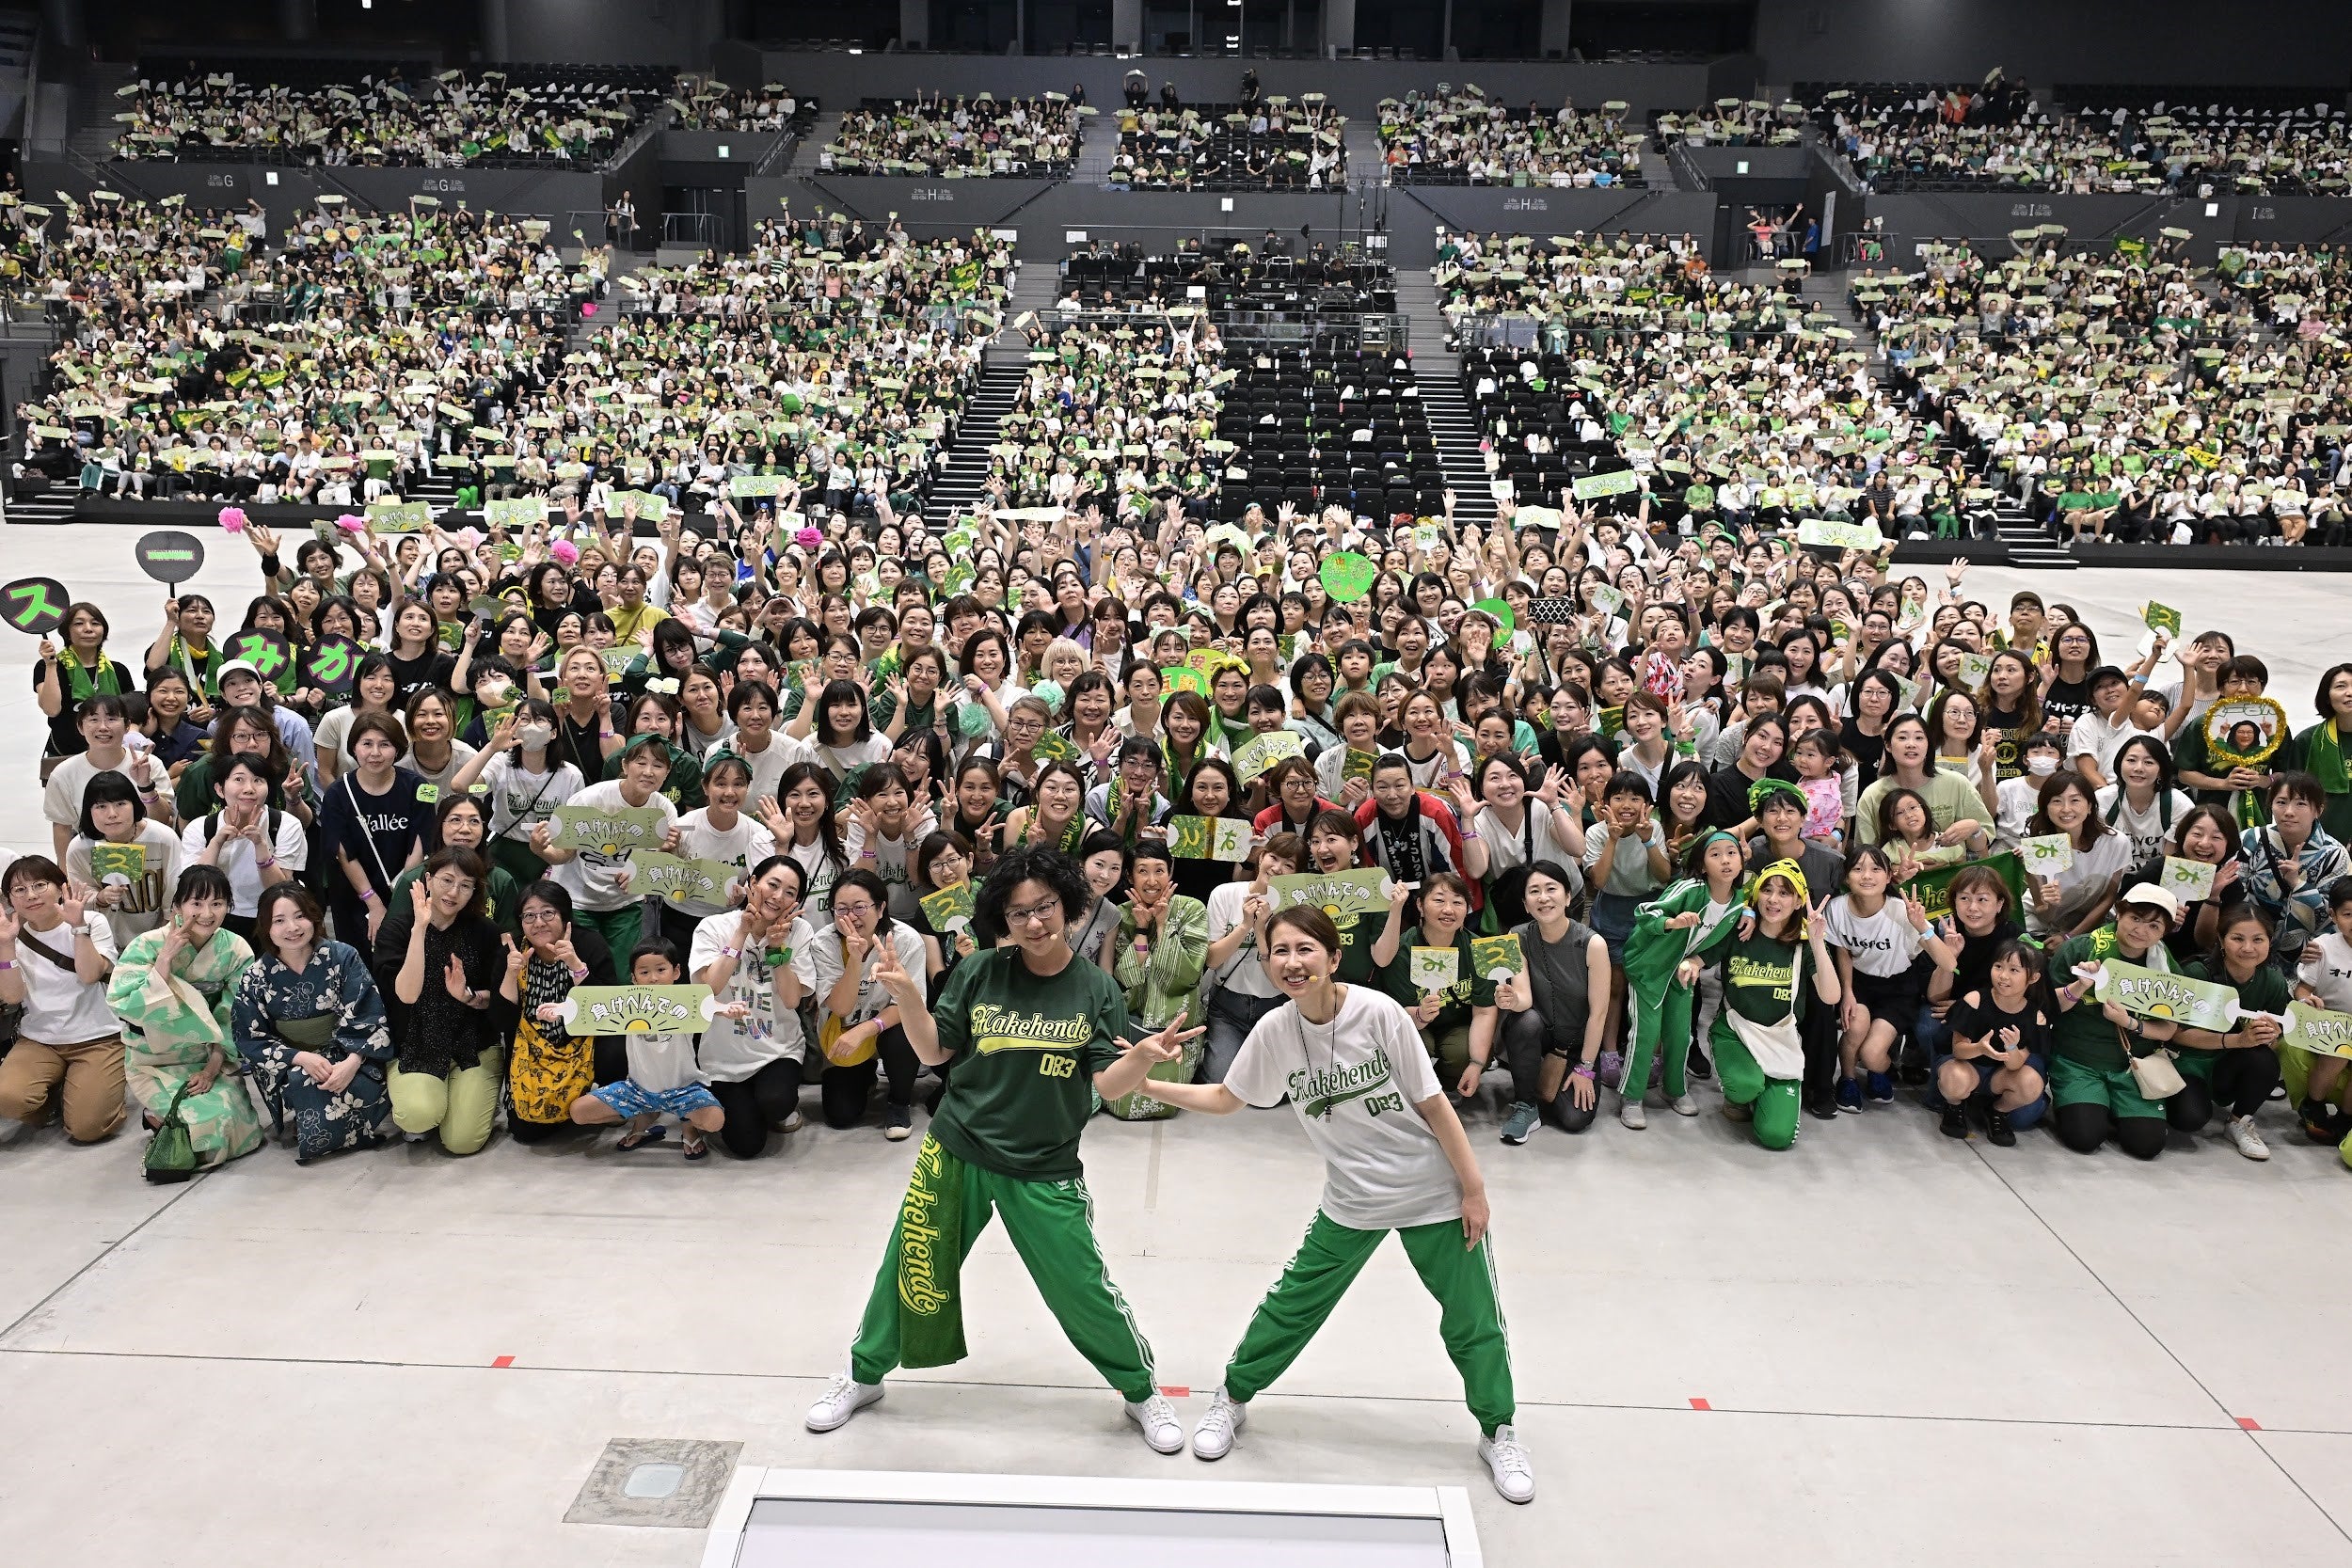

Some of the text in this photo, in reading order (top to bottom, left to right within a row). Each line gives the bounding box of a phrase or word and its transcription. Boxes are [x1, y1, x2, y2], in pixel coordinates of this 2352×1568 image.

[224, 174, 233, 186] G
[438, 180, 449, 191] G
[928, 188, 937, 200] H
[1520, 198, 1531, 210] H
[8, 582, 65, 628] ス
[235, 634, 286, 677] み
[308, 641, 367, 682] か
[356, 813, 409, 832] Vallée
[573, 817, 628, 838] 負けへんで
[2032, 843, 2058, 859] み
[647, 863, 700, 883] 負けへんで
[2174, 865, 2201, 884] み
[1291, 879, 1355, 906] 負けへんで
[1422, 955, 1447, 973] み
[2118, 975, 2196, 1006] 負けへんで
[589, 991, 672, 1023] 負けへんで
[971, 1003, 1092, 1042] Makehende
[1039, 1053, 1077, 1079] 083
[1286, 1045, 1391, 1103] Makehende
[1364, 1091, 1405, 1117] 083
